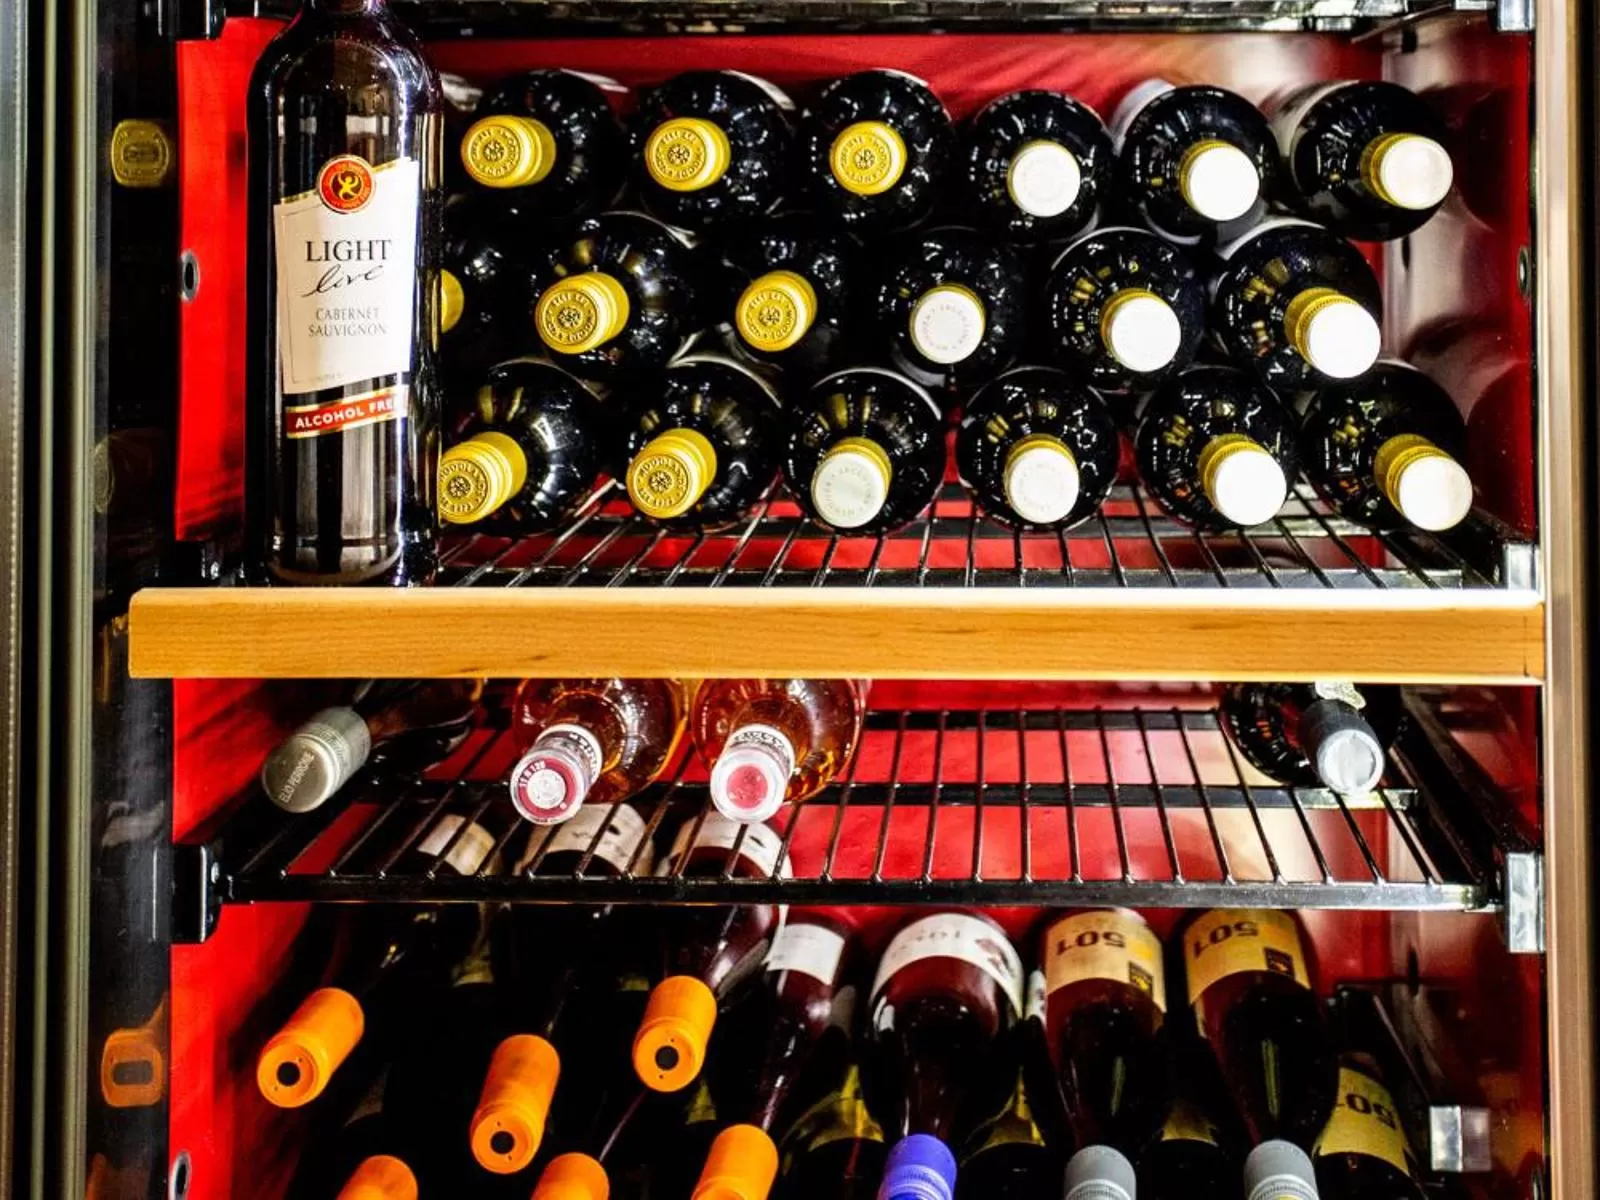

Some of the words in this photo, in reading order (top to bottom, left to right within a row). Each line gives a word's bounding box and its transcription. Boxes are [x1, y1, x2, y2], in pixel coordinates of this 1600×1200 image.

[306, 239, 392, 262] LIGHT
[301, 263, 384, 298] live
[316, 307, 380, 321] CABERNET
[308, 323, 389, 338] SAUVIGNON
[295, 405, 365, 429] ALCOHOL
[368, 396, 399, 416] FRE
